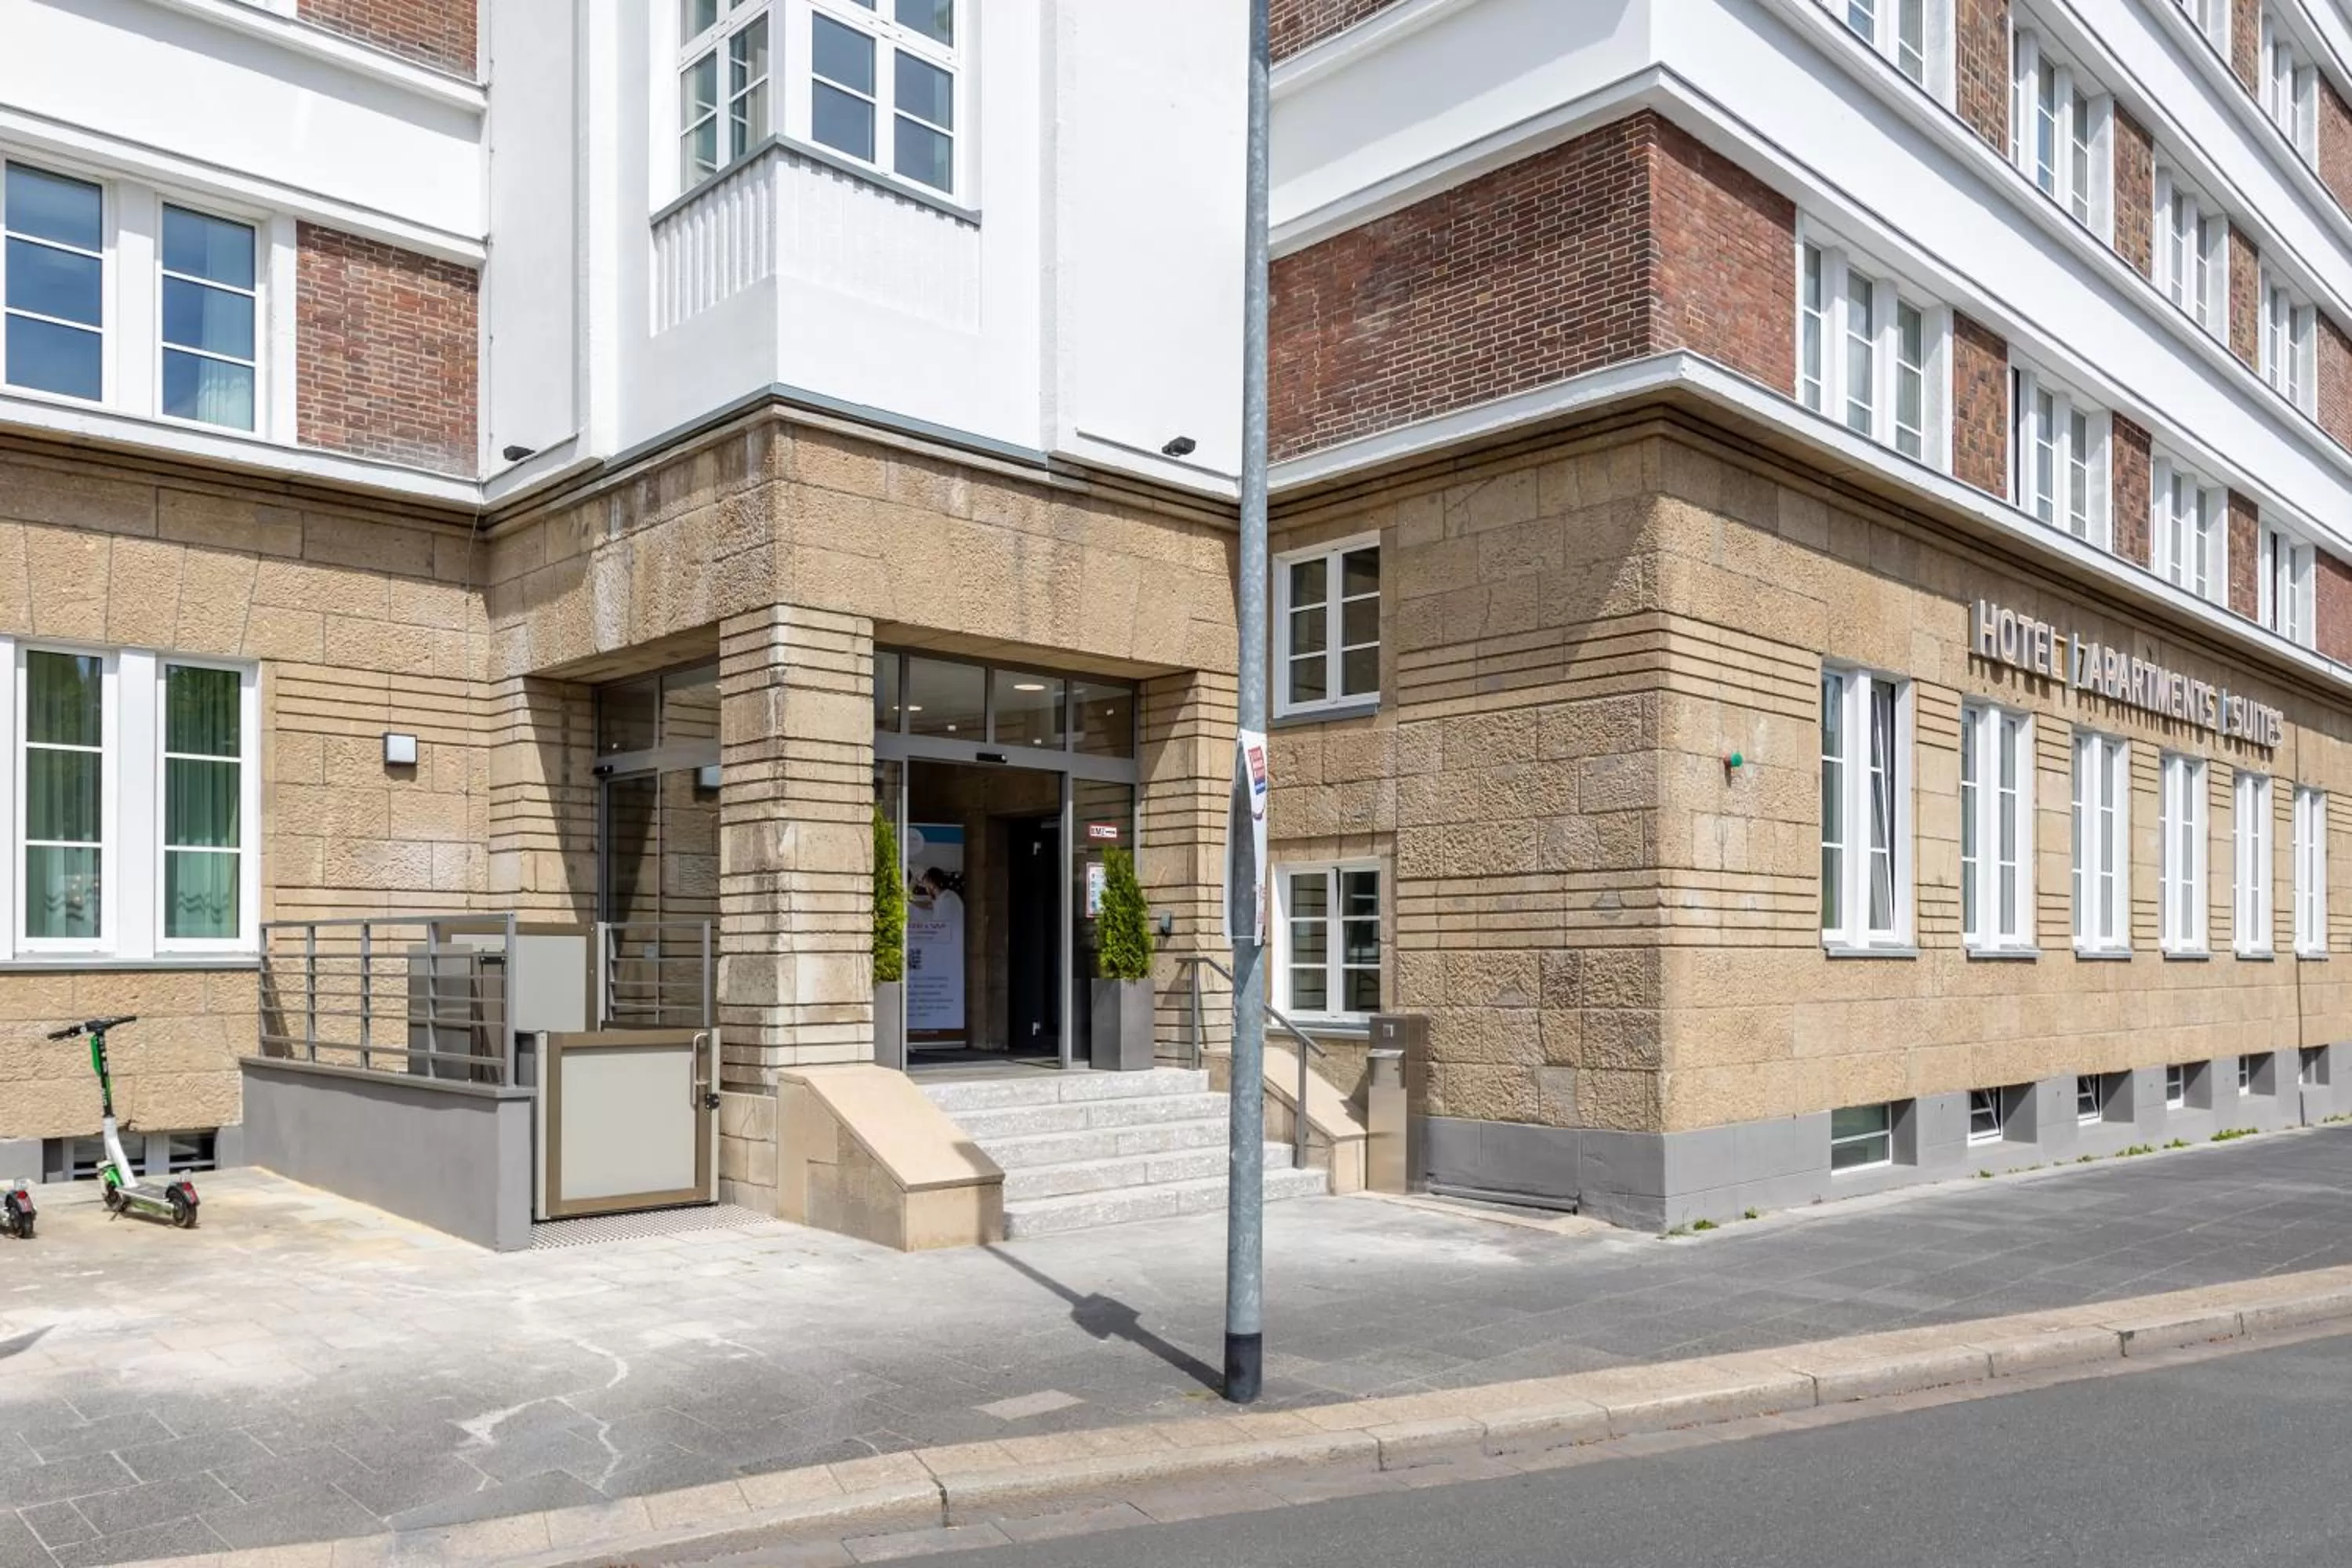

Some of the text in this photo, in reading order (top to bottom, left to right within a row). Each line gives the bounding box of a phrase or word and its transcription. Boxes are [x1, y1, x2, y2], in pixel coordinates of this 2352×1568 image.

[1976, 598, 2063, 682] HOTEL
[2086, 641, 2217, 730] APARTMENTS
[2232, 695, 2285, 748] SUITES
